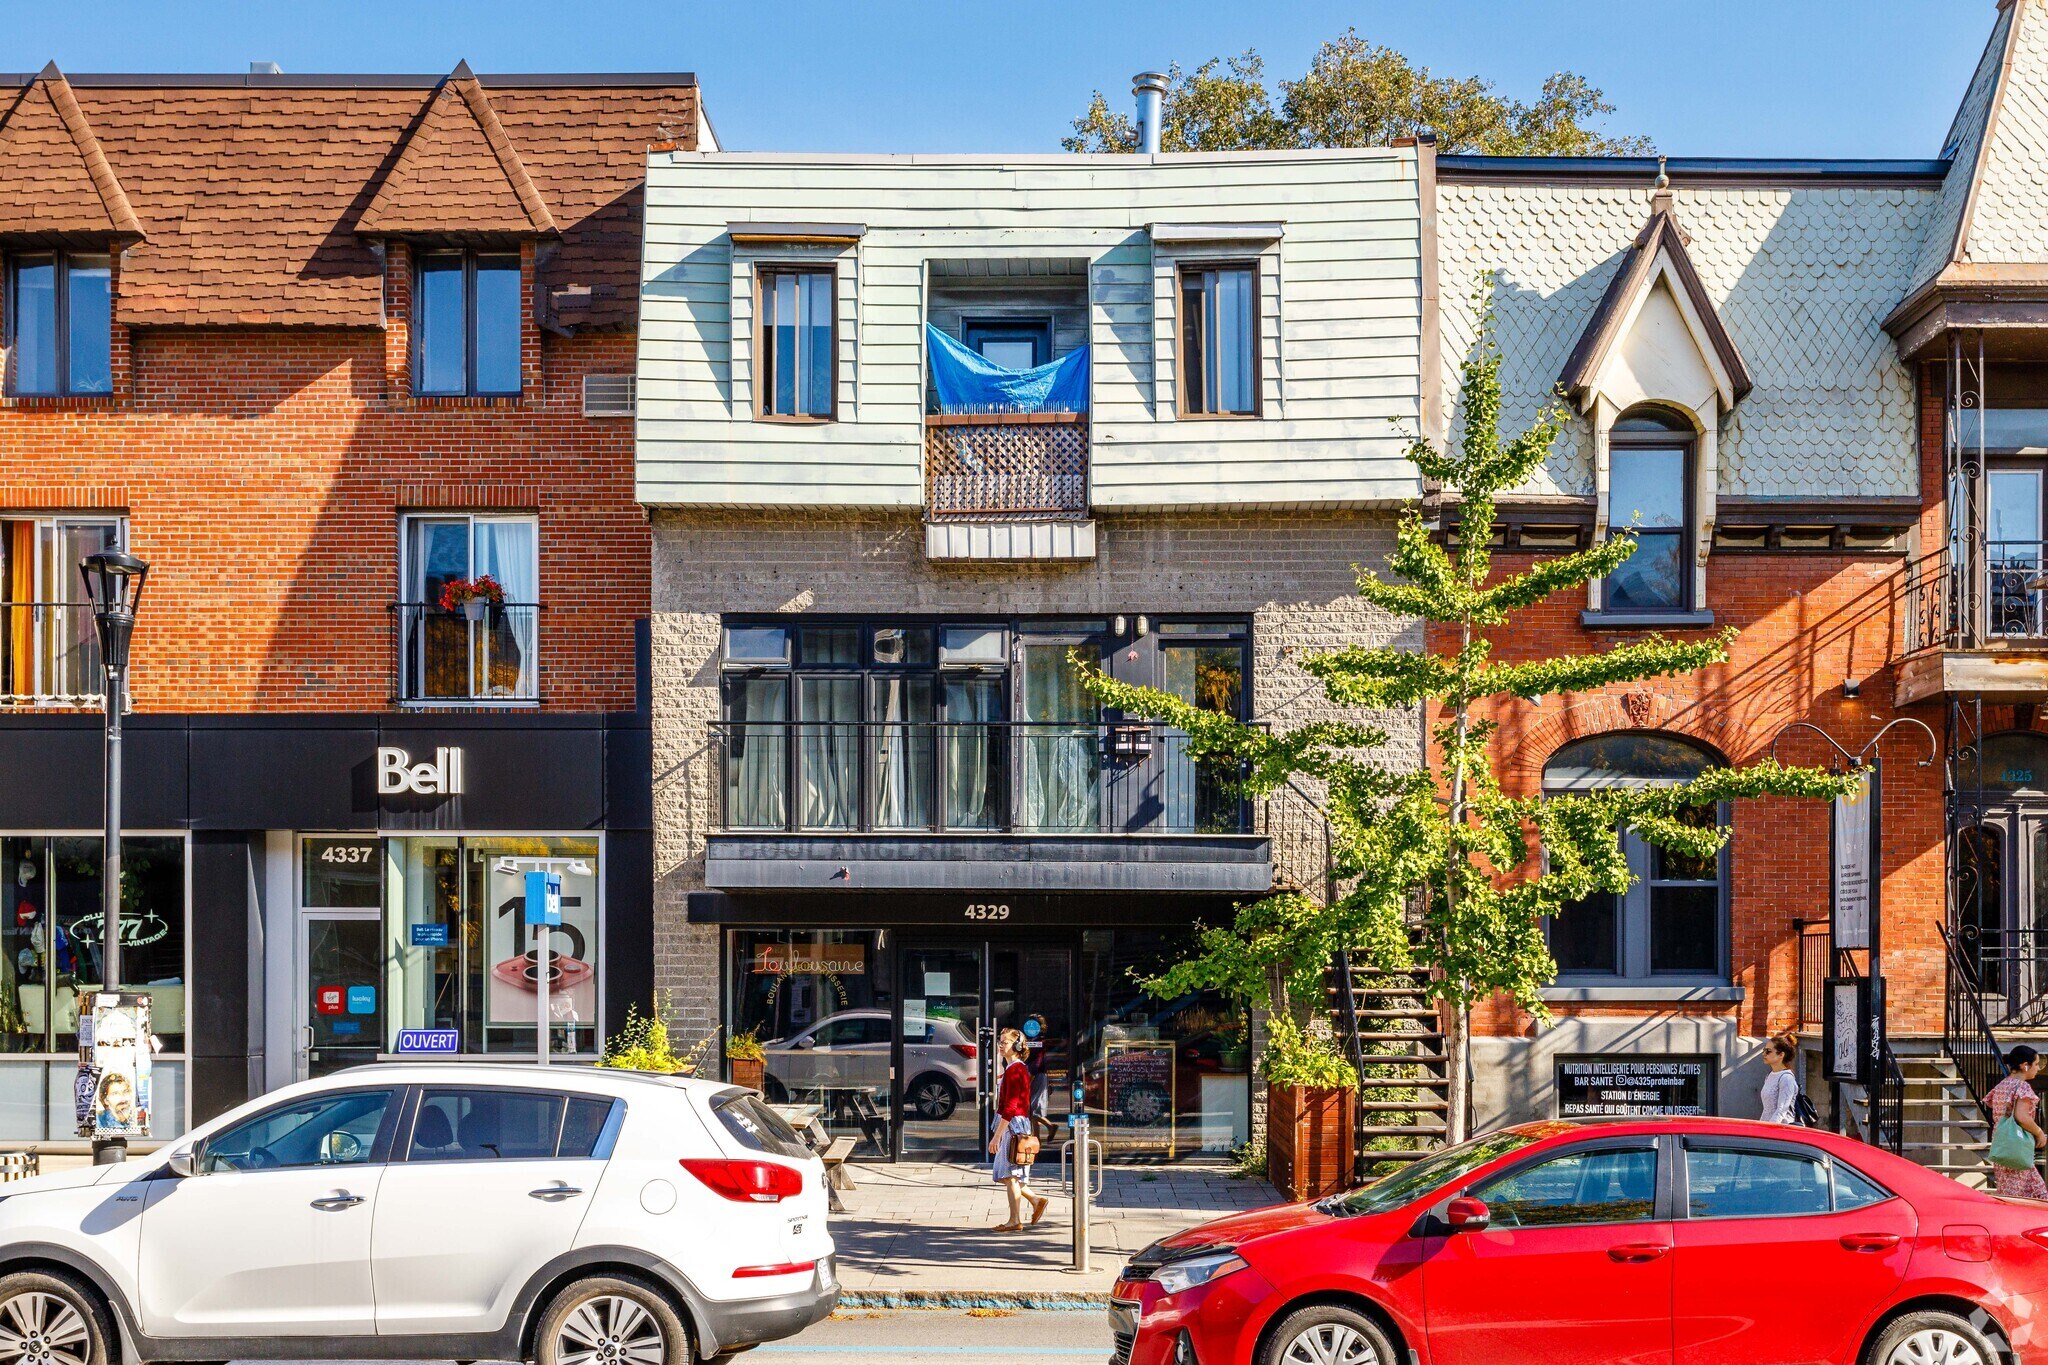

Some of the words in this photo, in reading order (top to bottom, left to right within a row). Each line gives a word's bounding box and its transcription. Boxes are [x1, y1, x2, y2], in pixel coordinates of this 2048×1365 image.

[378, 747, 462, 794] Bell
[321, 847, 373, 863] 4337
[83, 912, 104, 921] CLU
[964, 904, 1010, 920] 4329
[127, 929, 167, 947] VINTAGE
[751, 946, 864, 972] Toulousaine
[352, 995, 371, 1003] lucky
[402, 1033, 455, 1049] OUVERT
[1564, 1063, 1593, 1075] NUTRITION
[1593, 1063, 1630, 1075] INTELLIGENTE
[1630, 1063, 1645, 1075] POUR
[1645, 1063, 1678, 1075] PERSONNES
[1678, 1063, 1701, 1075] ACTIVES
[1574, 1076, 1589, 1086] BAR
[1590, 1076, 1614, 1086] SANTE
[1626, 1076, 1686, 1088] @4325proteinbar
[1600, 1090, 1627, 1101] STATION
[1627, 1088, 1661, 1101] D'ÉNERGIE
[1564, 1103, 1584, 1114] REPAS
[1584, 1102, 1604, 1114] SANTÉ
[1604, 1104, 1615, 1115] QUI
[1615, 1103, 1642, 1116] GOÛTENT
[1641, 1105, 1664, 1116] COMME
[1664, 1105, 1674, 1116] UN
[1674, 1105, 1700, 1116] DESSERT
